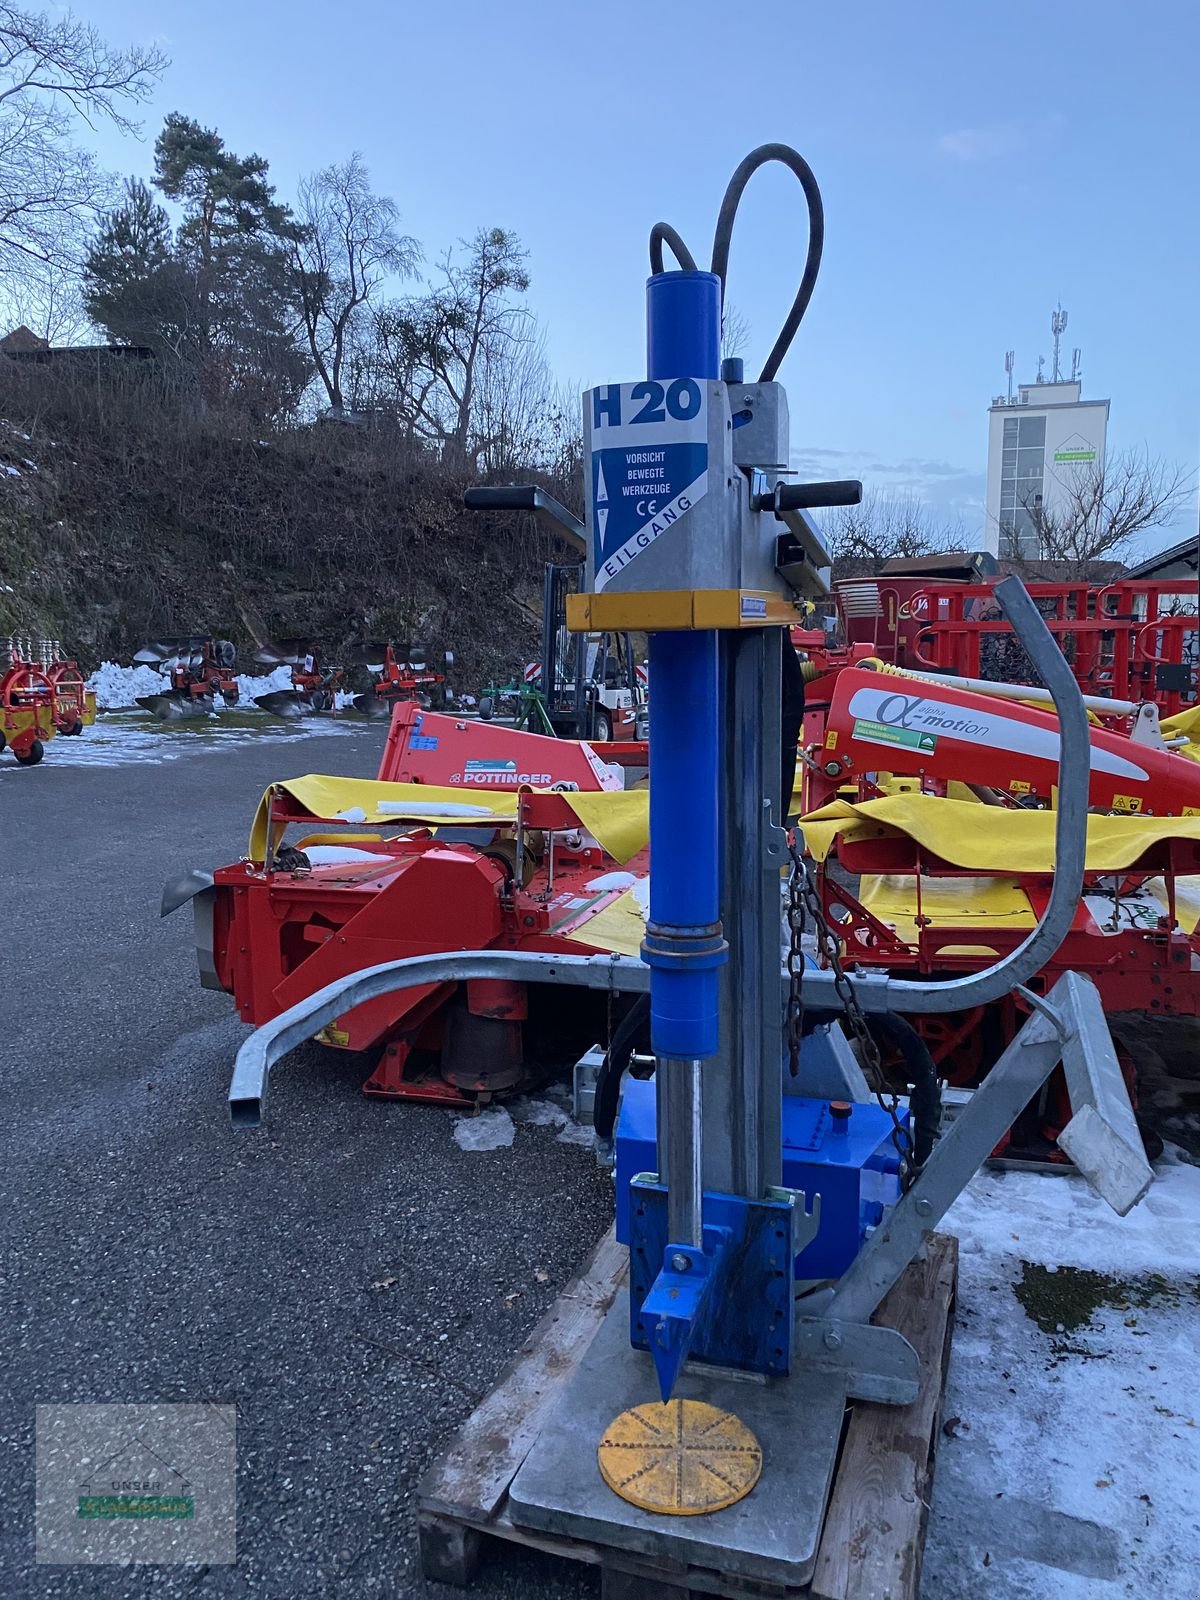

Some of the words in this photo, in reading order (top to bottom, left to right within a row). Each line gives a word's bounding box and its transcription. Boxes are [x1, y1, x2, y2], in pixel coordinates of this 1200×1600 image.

[626, 451, 666, 464] VORSICHT
[627, 467, 665, 480] BEWEGTE
[622, 483, 671, 496] WERKZEUGE
[604, 496, 692, 577] EILGANG
